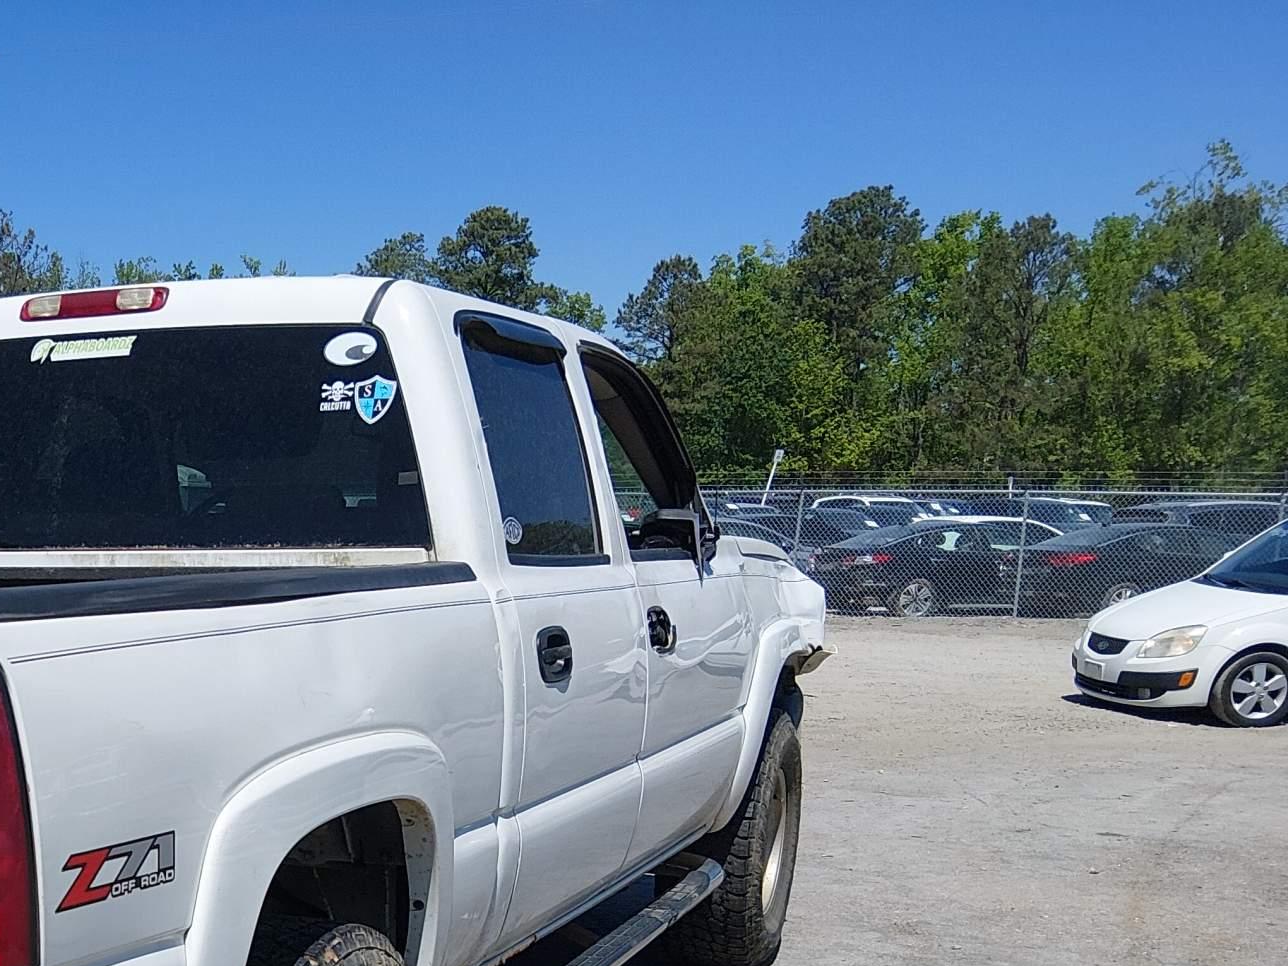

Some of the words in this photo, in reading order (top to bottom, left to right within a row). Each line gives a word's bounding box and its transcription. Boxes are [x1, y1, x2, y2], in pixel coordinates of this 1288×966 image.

[320, 401, 351, 411] CALCUTTA
[55, 830, 175, 914] Z71
[112, 879, 136, 898] OFF
[140, 869, 174, 889] ROAD
